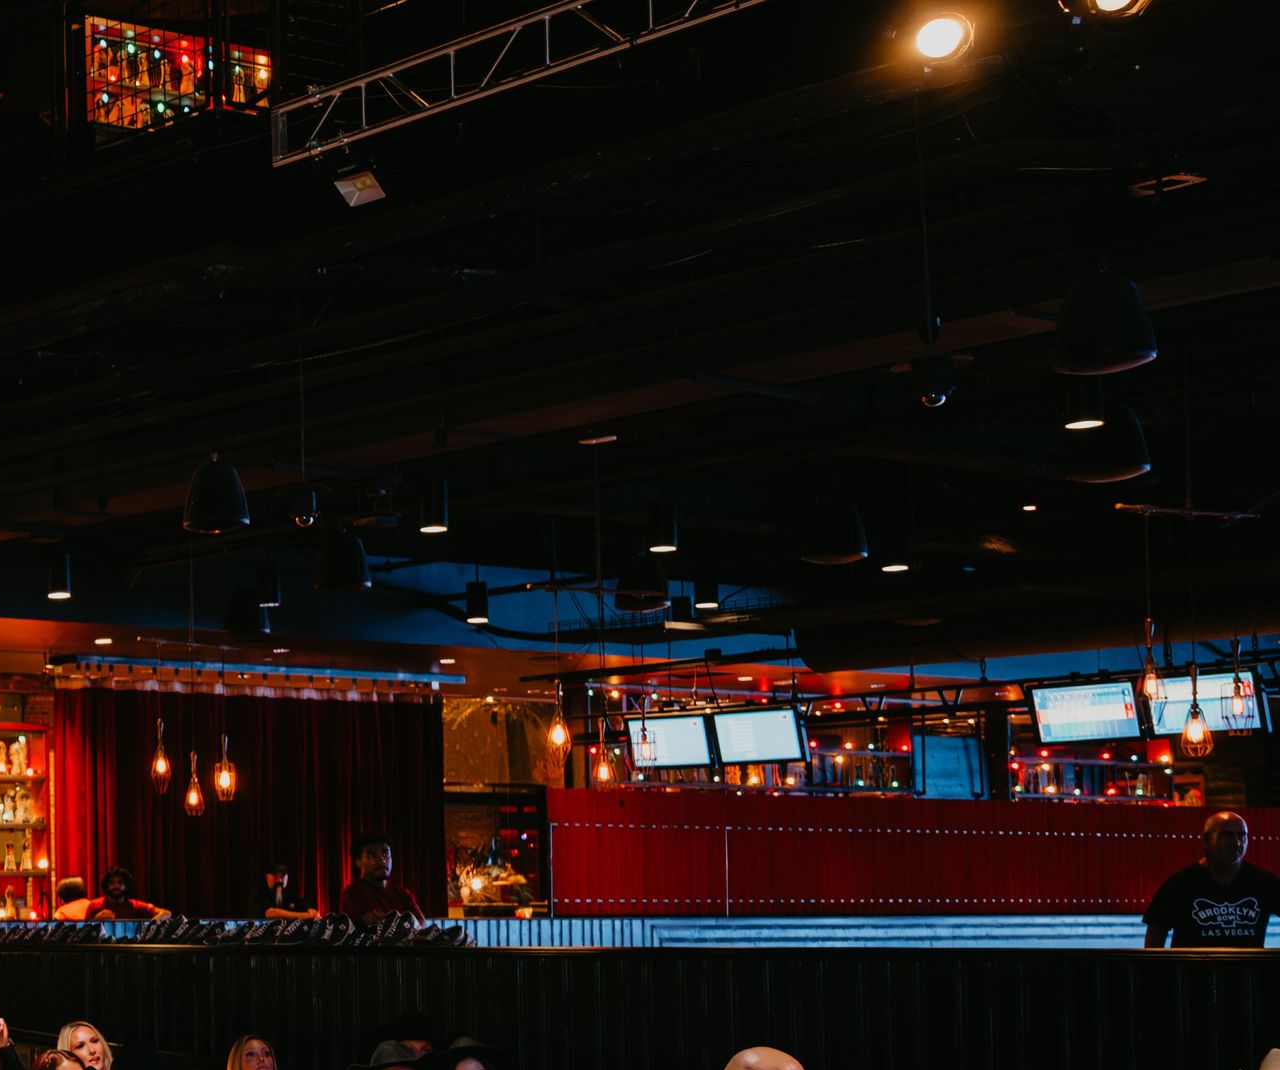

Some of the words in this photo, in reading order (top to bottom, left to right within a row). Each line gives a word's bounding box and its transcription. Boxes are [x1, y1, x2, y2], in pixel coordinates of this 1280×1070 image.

[1198, 905, 1256, 920] BROOKLYN
[1217, 914, 1241, 922] BOWL
[1201, 929, 1221, 937] LAS
[1224, 928, 1256, 937] VEGAS
